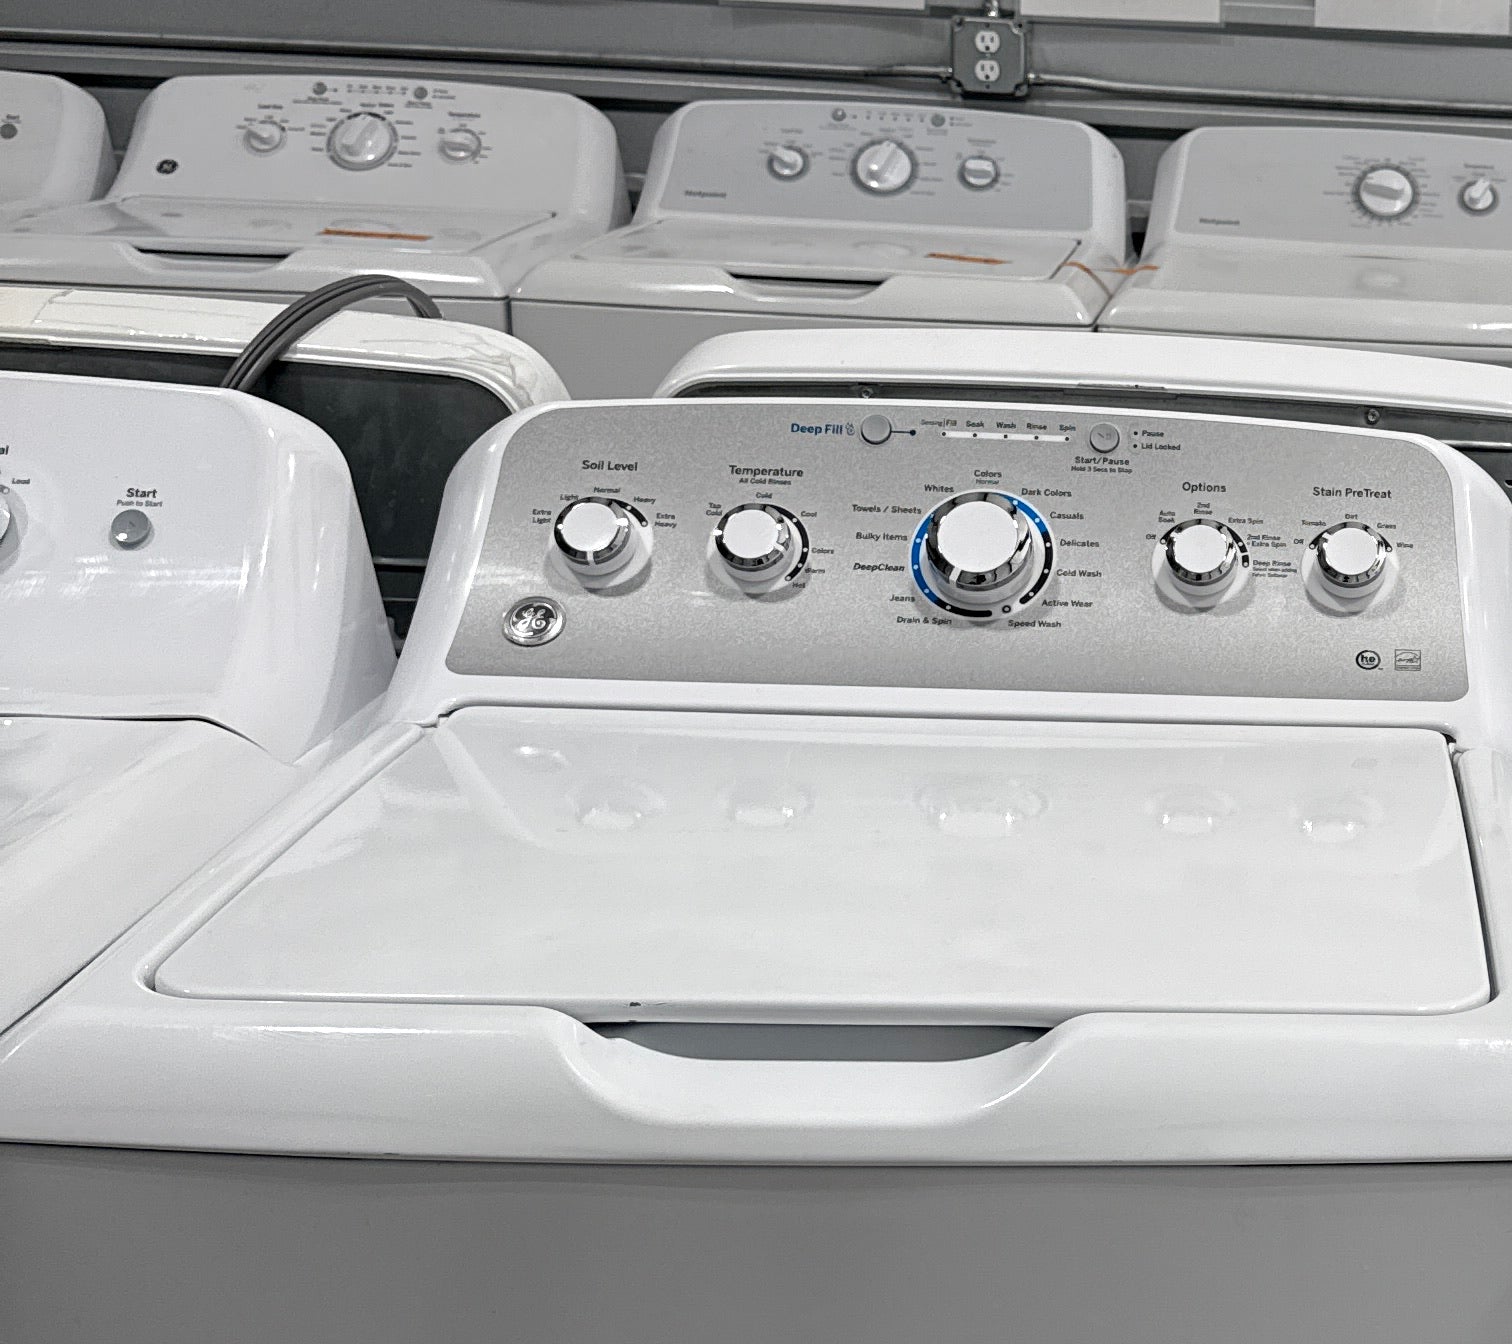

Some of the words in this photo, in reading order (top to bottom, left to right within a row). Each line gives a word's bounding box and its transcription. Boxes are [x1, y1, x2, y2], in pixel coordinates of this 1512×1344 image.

[791, 423, 822, 437] Deep
[824, 423, 843, 435] Fill
[966, 420, 985, 428] Soak
[996, 421, 1017, 429] Wash
[1059, 424, 1076, 432] Spin
[1155, 443, 1181, 451] Locked
[582, 459, 605, 472] Soil
[608, 461, 638, 472] Level
[1075, 456, 1130, 466] Start/Pause
[729, 465, 804, 480] Temperature
[974, 470, 1002, 478] Colors
[924, 484, 954, 493] Whites
[1182, 482, 1226, 493] Options
[126, 488, 157, 498] Start
[1021, 488, 1042, 496] Dark
[1044, 489, 1072, 497] Colors
[1313, 486, 1343, 497] Stain
[1345, 488, 1392, 499] PreTreat
[852, 504, 880, 513] Towels
[891, 506, 922, 515] Sheets
[1050, 511, 1084, 520] Casuals
[856, 533, 883, 542] Bulky
[884, 533, 907, 541] Items
[1060, 539, 1099, 548] Delicates
[853, 563, 905, 572] DeepClean
[1056, 569, 1074, 577] Cold
[1076, 570, 1102, 578] Wash
[890, 595, 915, 603] Jeans
[1042, 599, 1068, 607] Active
[1070, 600, 1093, 608] Wear
[897, 616, 921, 625] Drain
[932, 616, 952, 626] Spin
[1008, 620, 1034, 629] Speed
[1036, 620, 1061, 628] Wash
